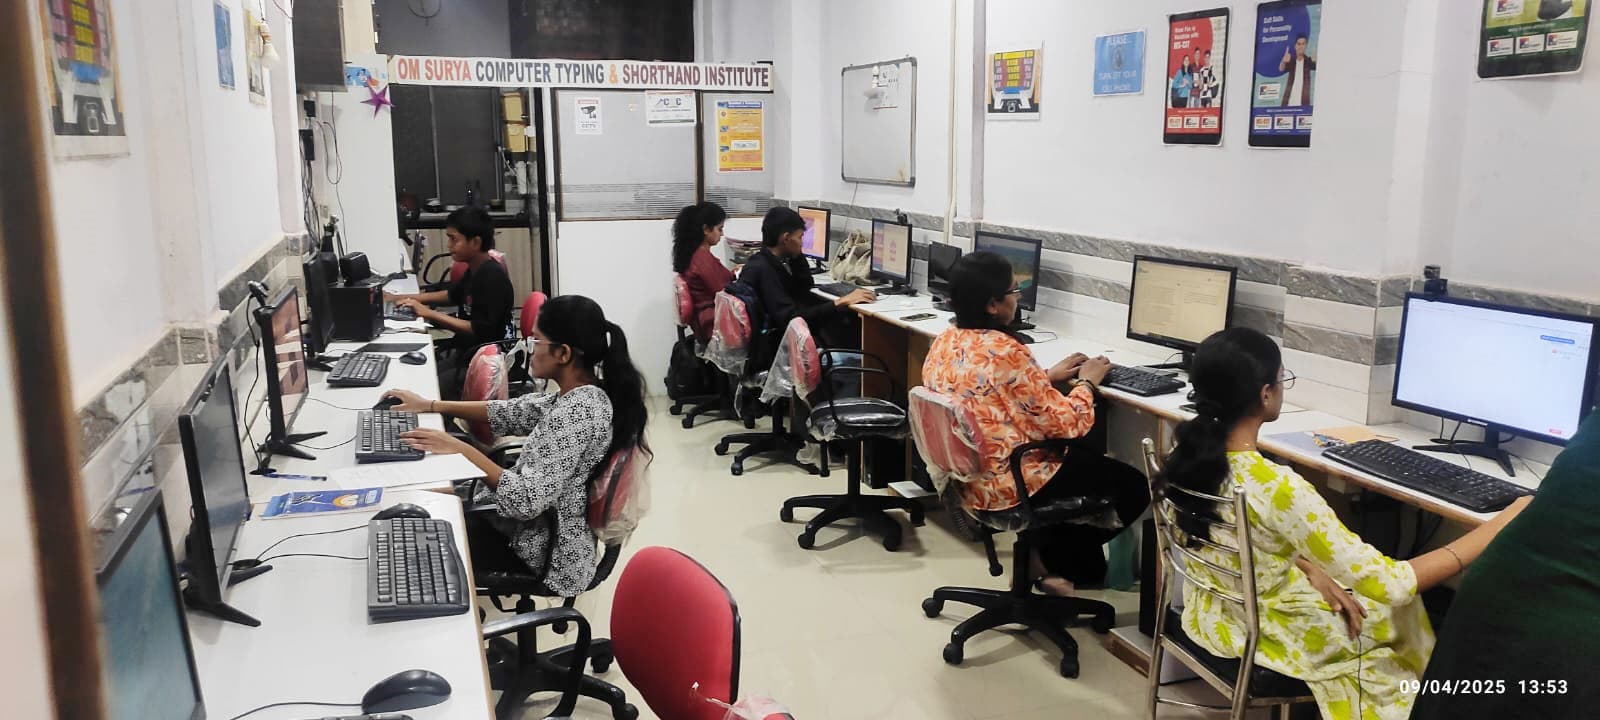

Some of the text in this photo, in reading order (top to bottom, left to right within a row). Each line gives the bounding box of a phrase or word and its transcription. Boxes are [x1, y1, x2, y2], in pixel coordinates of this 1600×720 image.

[398, 58, 769, 87] OM SURYA COMPUTER TYPING & SHORTHAND INSTITUTE
